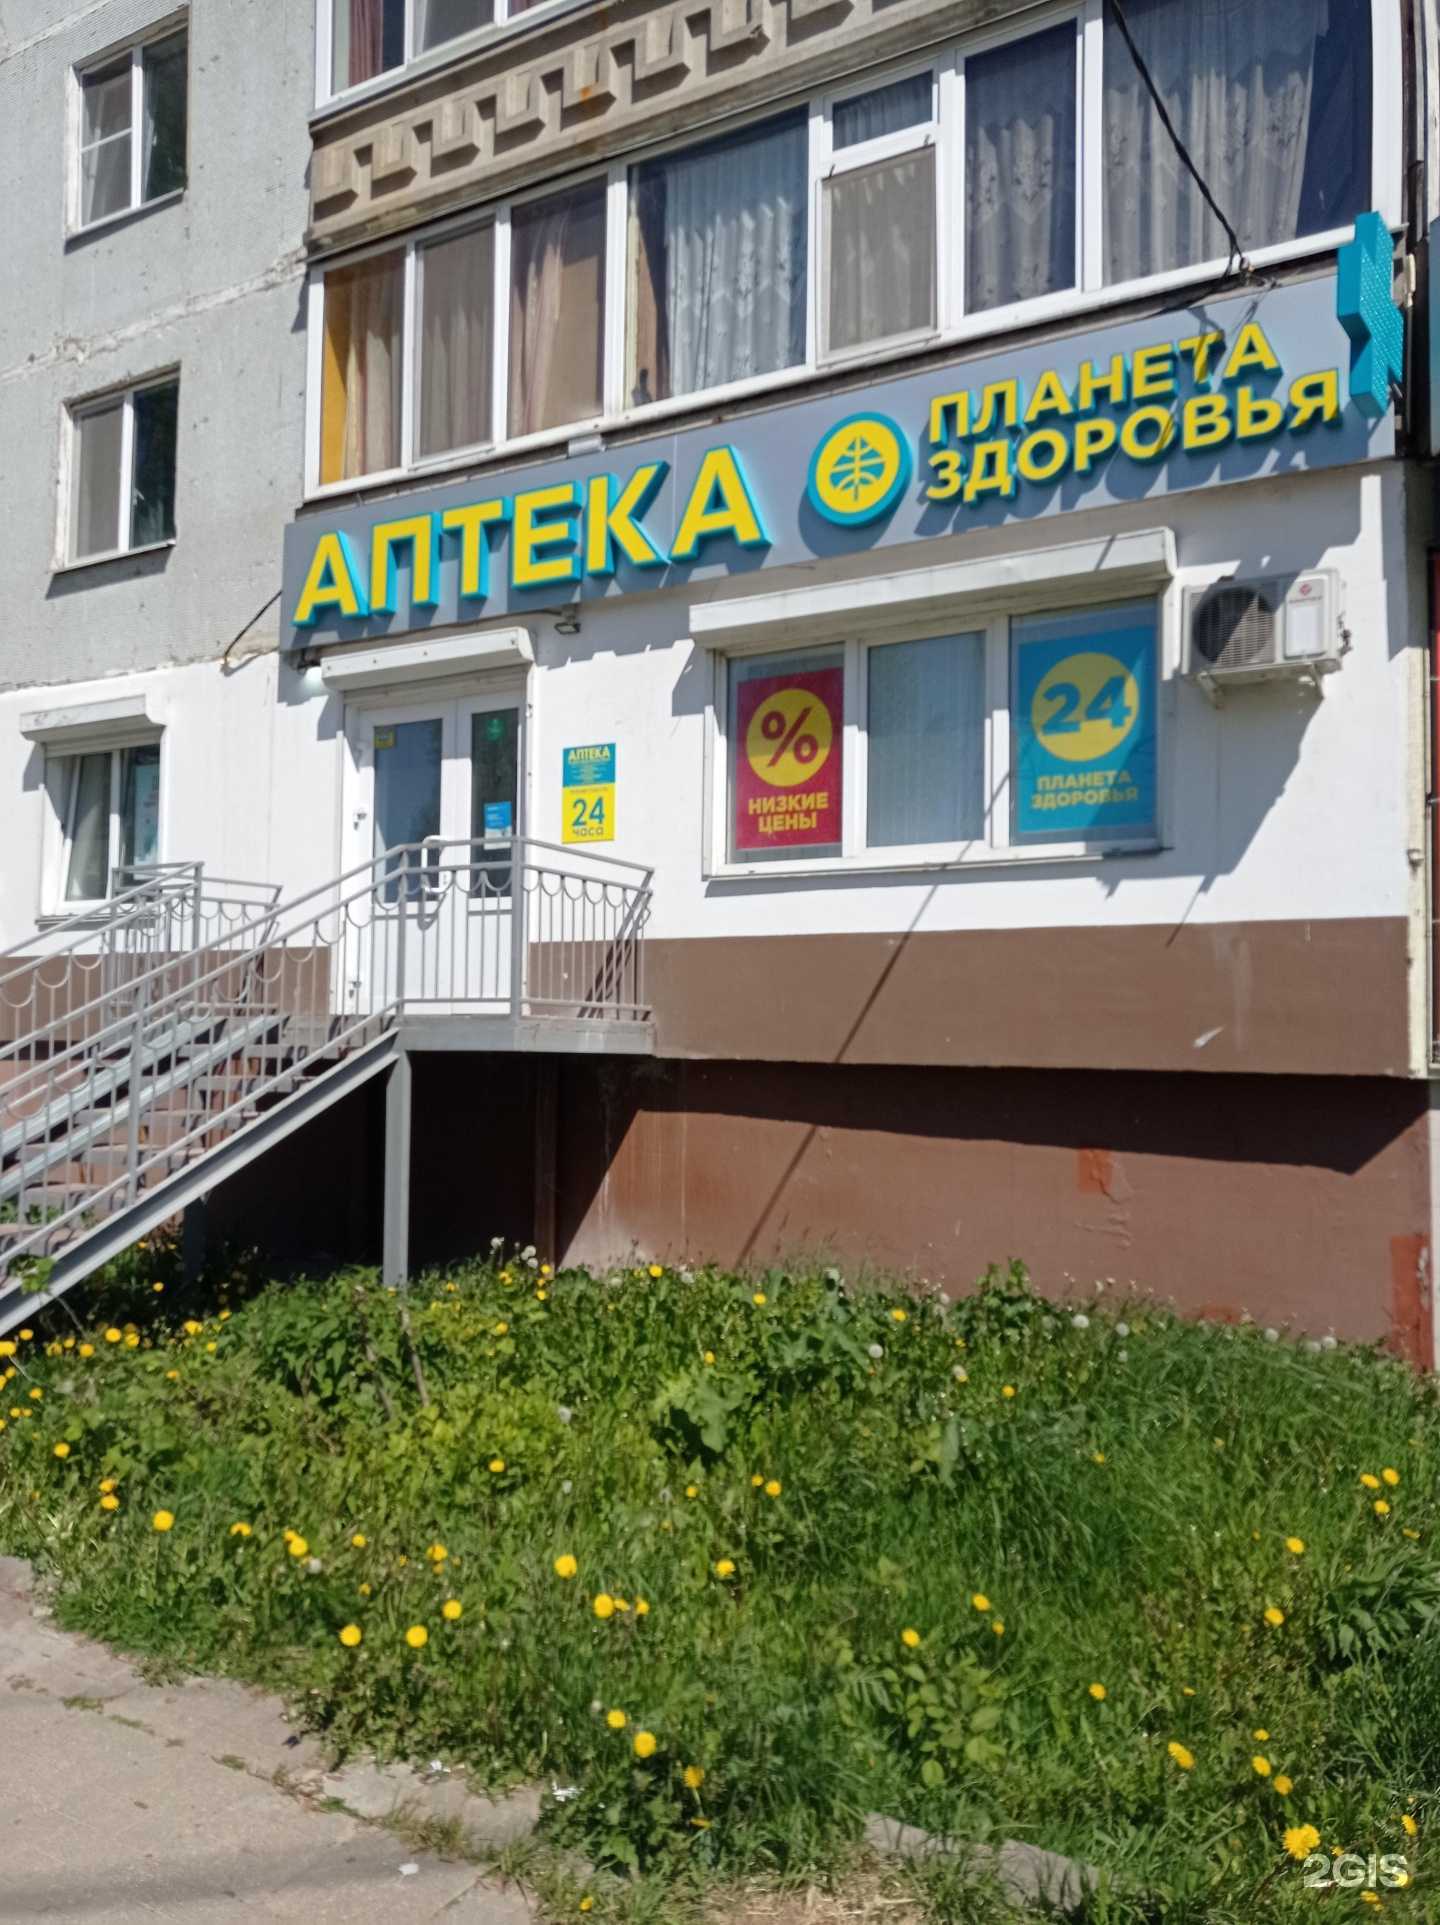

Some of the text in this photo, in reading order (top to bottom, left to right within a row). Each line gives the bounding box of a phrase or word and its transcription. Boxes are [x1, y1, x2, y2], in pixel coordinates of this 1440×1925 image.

[928, 322, 1283, 448] ПЛАНЕТА
[926, 368, 1341, 503] ЗДОРОВЬЯ
[292, 443, 772, 628] АПТЕКА
[1040, 674, 1133, 737] 24
[568, 746, 610, 763] АПТЕКА
[1037, 769, 1132, 791] ПЛАНЕТА
[572, 796, 605, 827] 24
[748, 791, 829, 816] НИЗКИЕ
[1031, 786, 1138, 811] ЗДОРОВЬЯ
[758, 811, 817, 834] ЦЕНЫ
